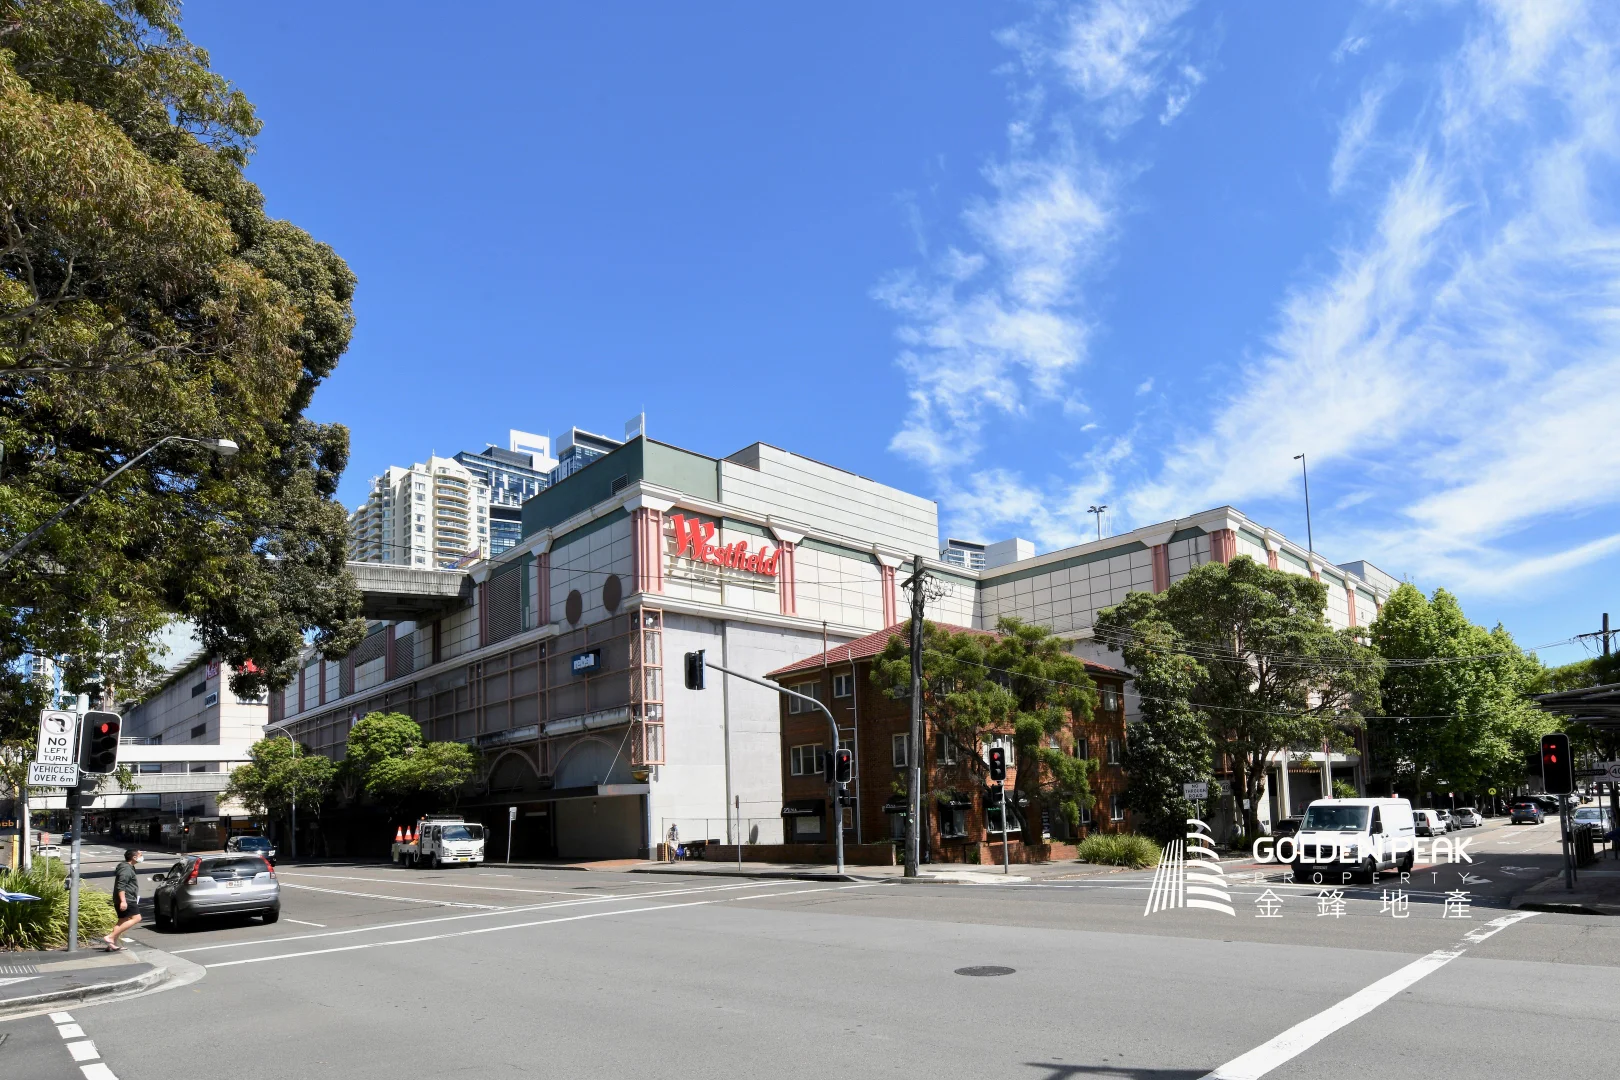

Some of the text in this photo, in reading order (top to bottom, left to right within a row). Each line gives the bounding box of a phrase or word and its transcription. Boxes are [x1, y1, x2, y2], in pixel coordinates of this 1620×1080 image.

[670, 513, 783, 577] Westfield
[48, 738, 66, 746] NO
[34, 766, 74, 774] VEHICLES
